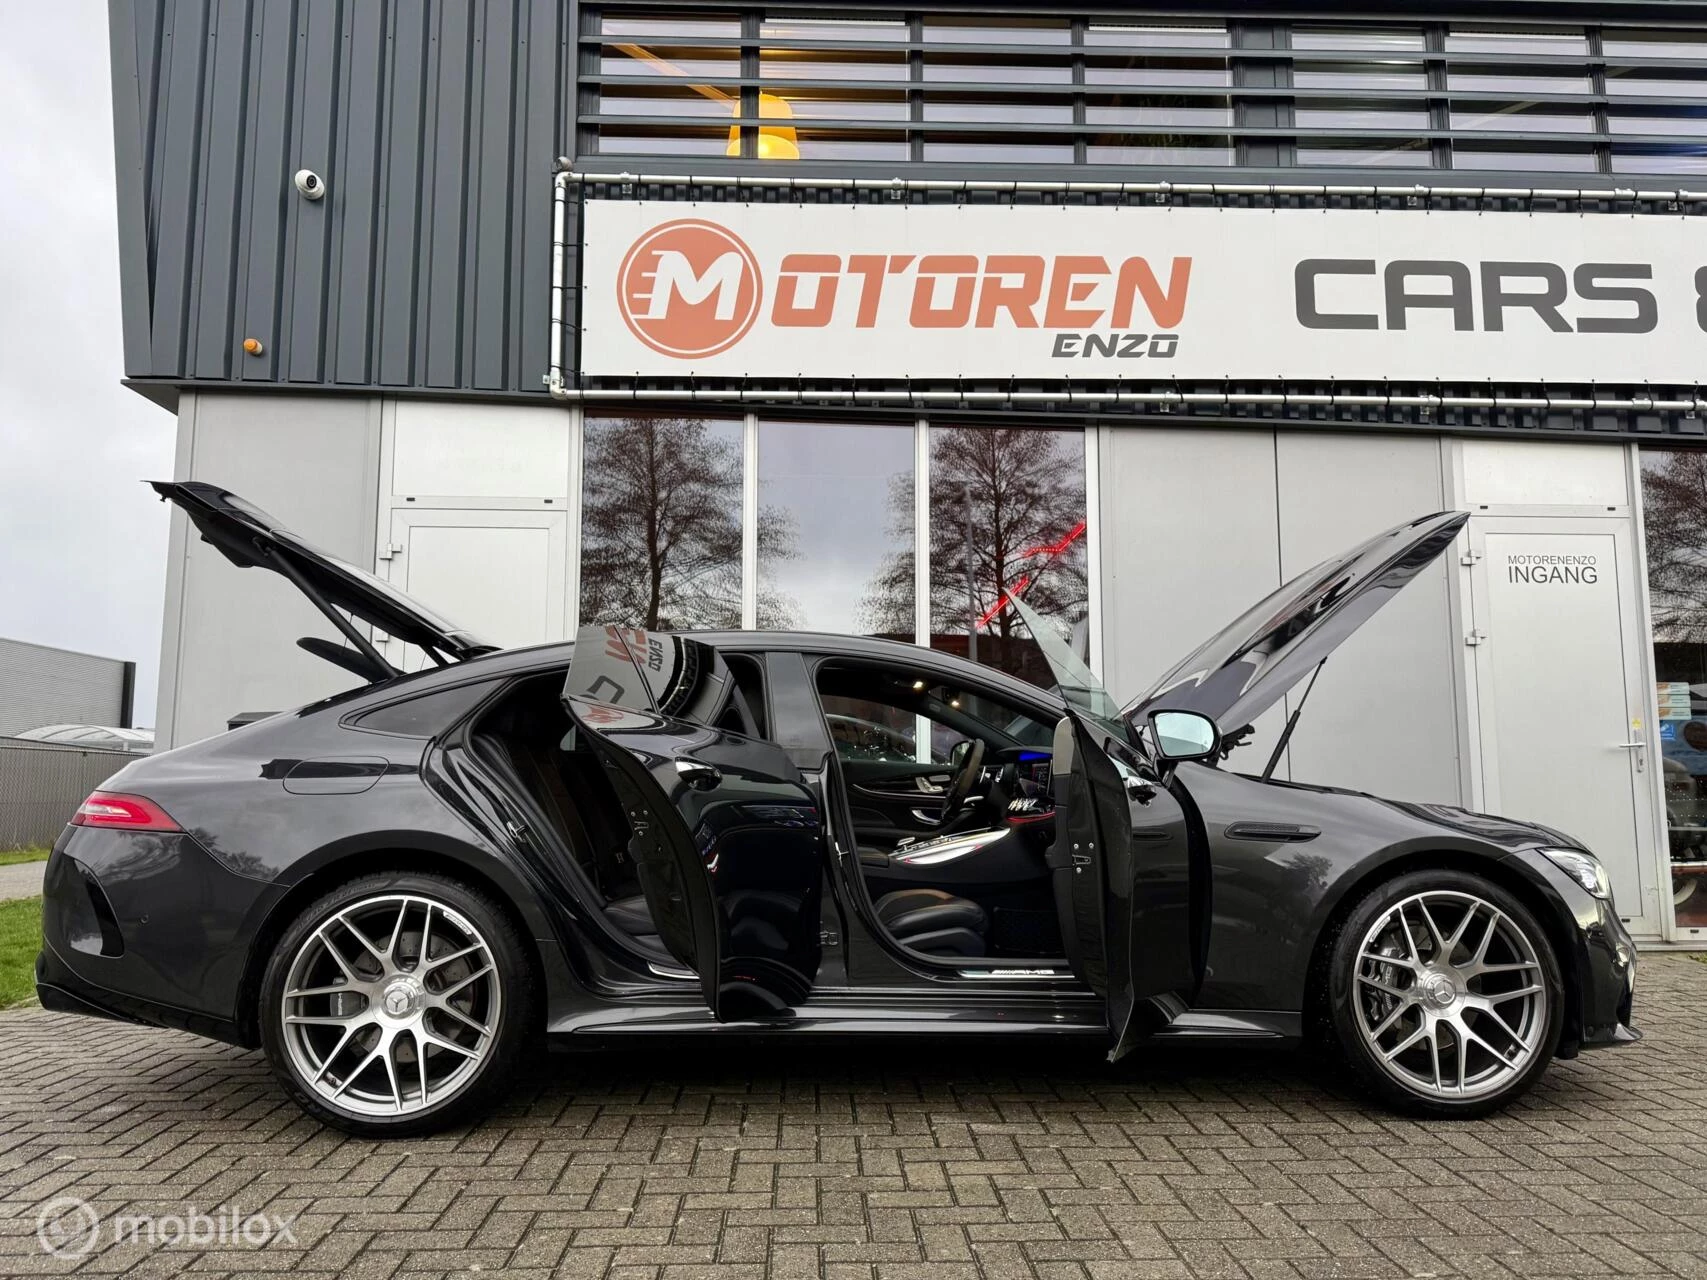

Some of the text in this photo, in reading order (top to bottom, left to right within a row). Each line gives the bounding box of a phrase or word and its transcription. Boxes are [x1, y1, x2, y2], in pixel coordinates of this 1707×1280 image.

[1295, 258, 1658, 334] CARS
[1052, 333, 1180, 358] ENZO
[1508, 555, 1597, 565] MOTORENENZO
[1508, 566, 1598, 584] INGANG
